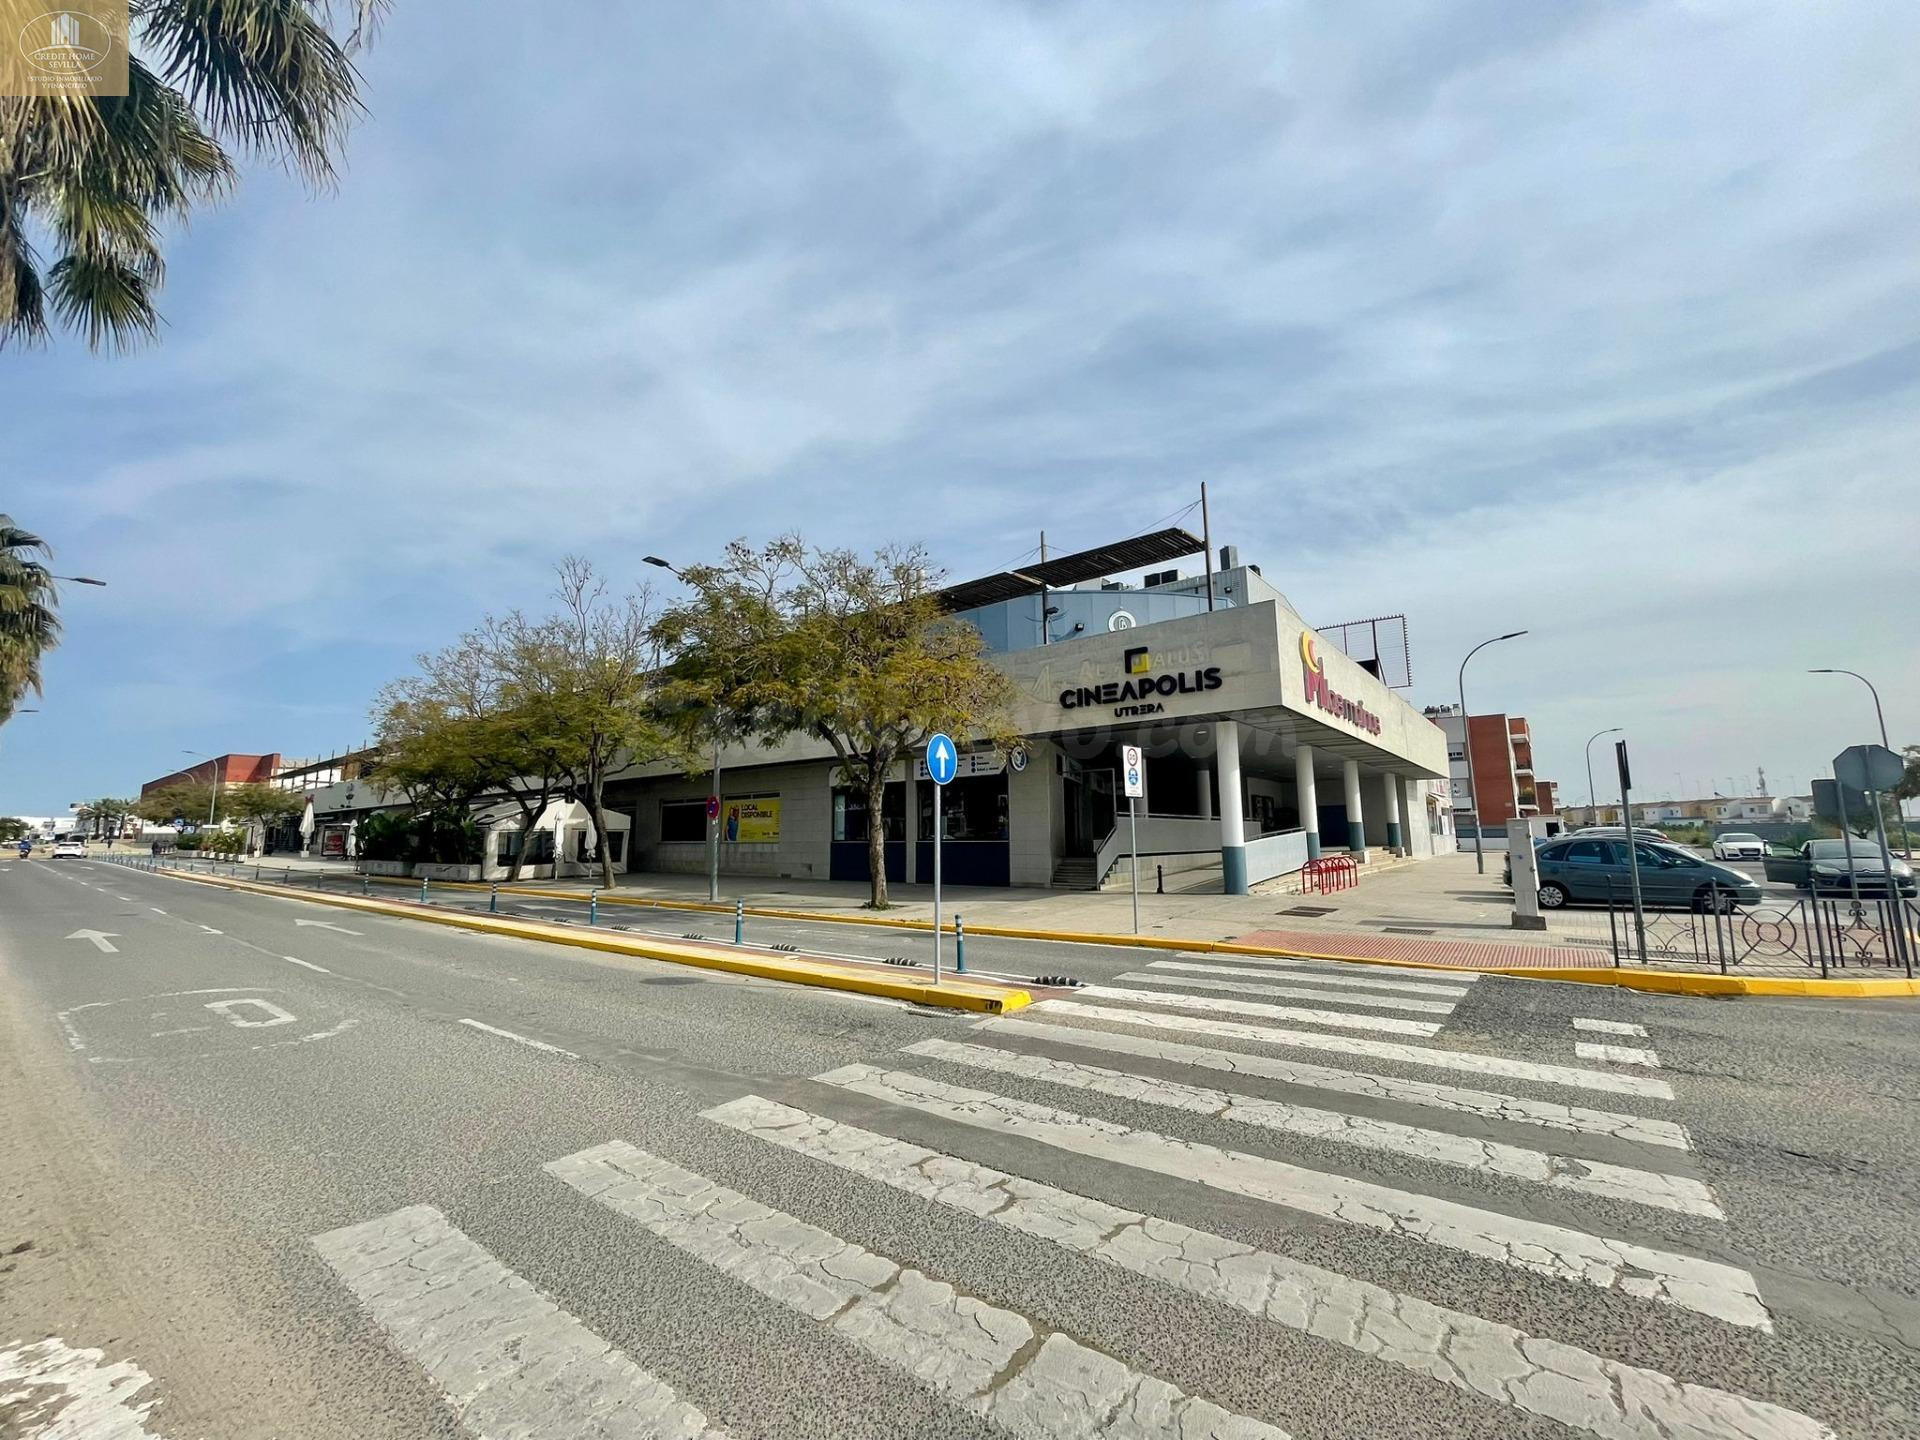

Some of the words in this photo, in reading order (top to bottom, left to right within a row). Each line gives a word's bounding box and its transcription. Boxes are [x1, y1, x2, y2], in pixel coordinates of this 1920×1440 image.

[1059, 667, 1223, 709] CINEAPOLIS
[1114, 702, 1165, 718] UTRERA
[741, 810, 773, 819] DISPONIBLE
